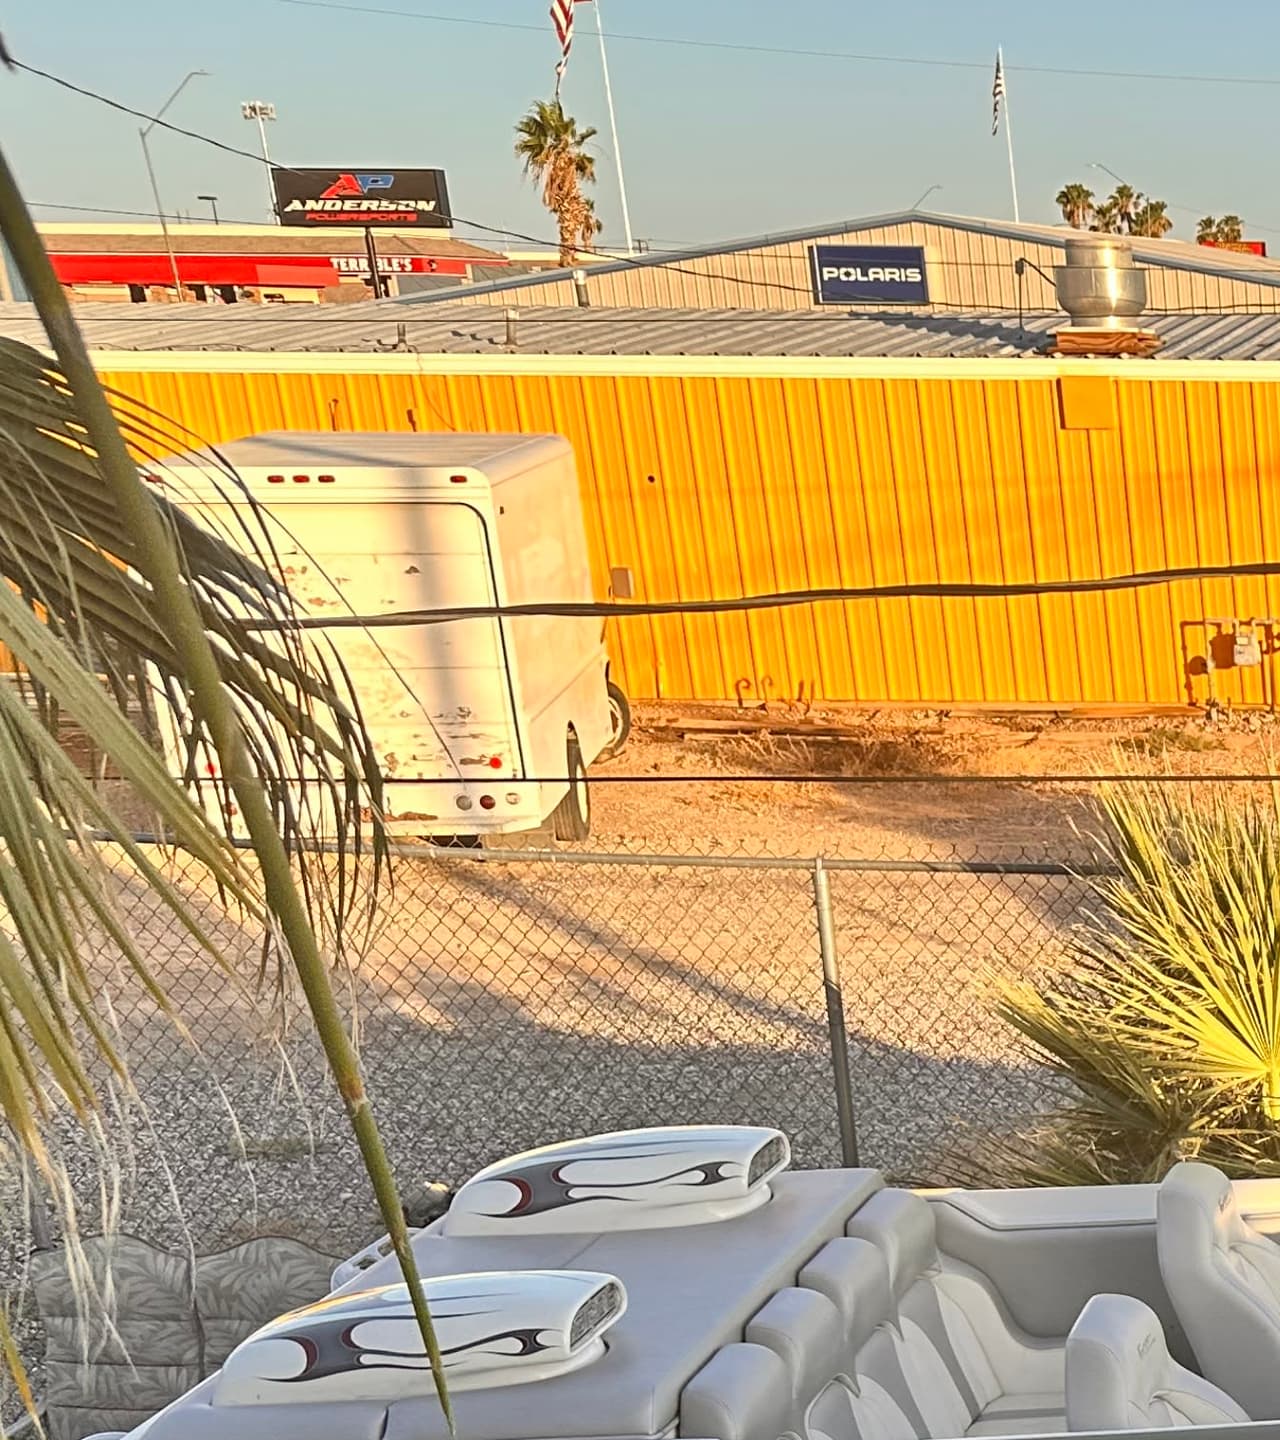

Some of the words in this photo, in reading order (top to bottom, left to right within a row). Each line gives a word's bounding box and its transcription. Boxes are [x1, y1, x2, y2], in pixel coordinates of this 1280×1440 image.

[283, 199, 437, 212] ANDERSON
[329, 257, 413, 272] TERRBLE'S
[822, 267, 922, 282] POLARIS
